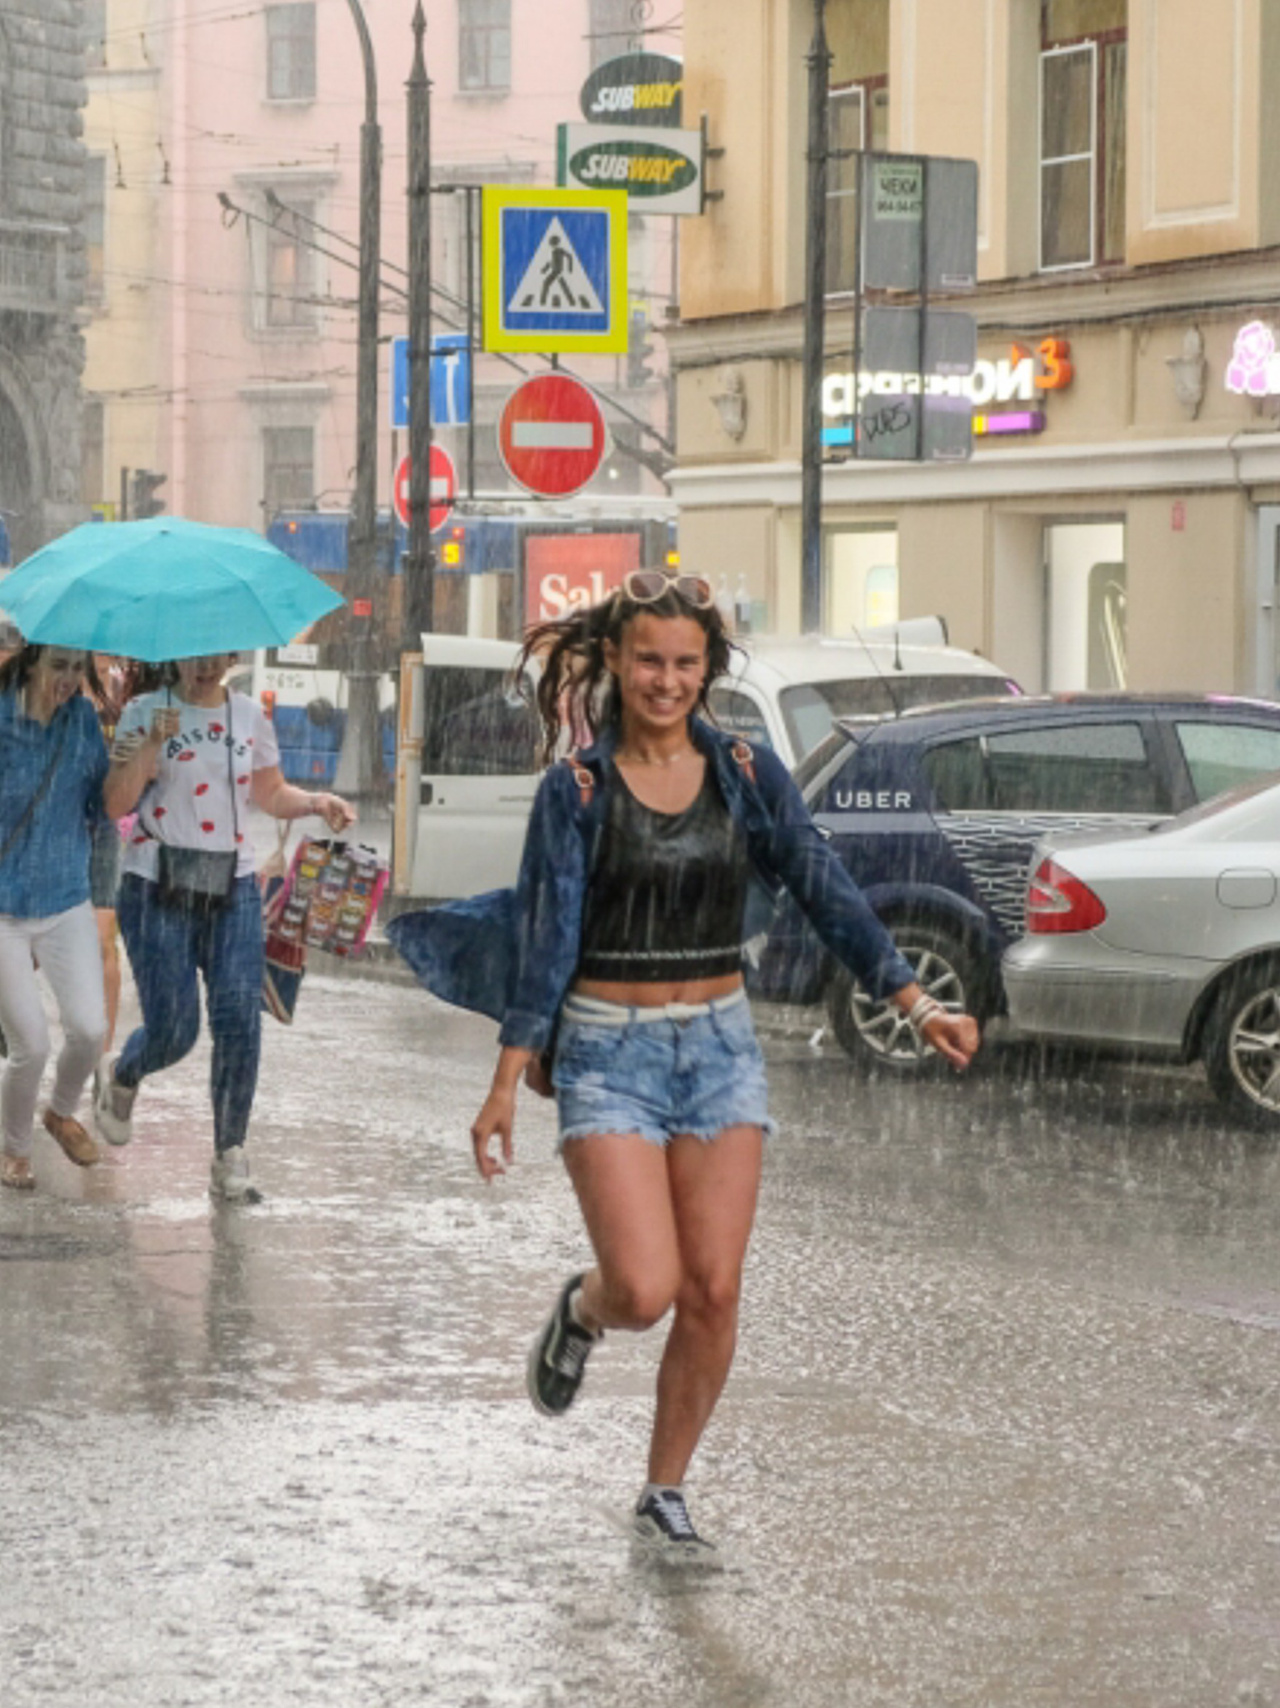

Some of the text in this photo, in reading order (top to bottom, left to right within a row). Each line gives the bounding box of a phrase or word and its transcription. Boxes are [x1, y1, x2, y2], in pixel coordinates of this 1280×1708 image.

[590, 81, 683, 113] SUBWAY
[580, 154, 687, 184] SUBWAY
[835, 790, 912, 809] UBER
